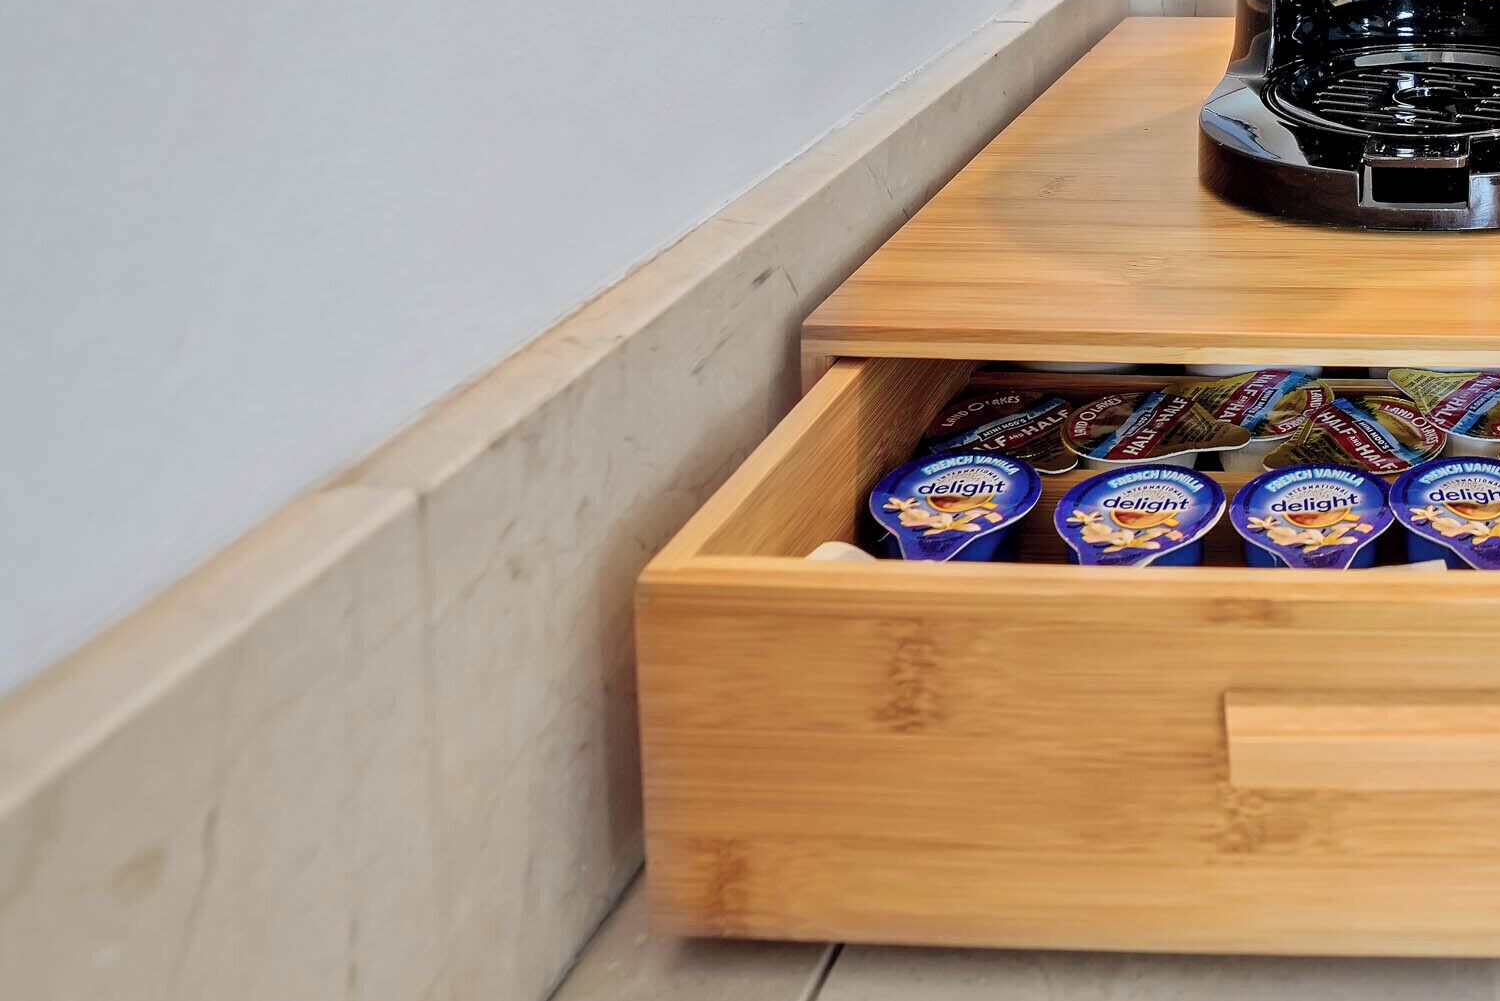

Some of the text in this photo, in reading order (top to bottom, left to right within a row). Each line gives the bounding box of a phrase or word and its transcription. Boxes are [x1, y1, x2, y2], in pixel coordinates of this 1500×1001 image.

[1243, 374, 1276, 396] HALF
[1081, 411, 1096, 421] O
[1094, 395, 1122, 413] LAKES
[1310, 389, 1321, 408] LAND
[1216, 403, 1244, 422] HA
[1432, 397, 1461, 425] HALF
[972, 435, 1007, 451] LF
[1021, 409, 1071, 436] HALF
[1122, 428, 1157, 455] HALF
[1158, 396, 1188, 423] HALF
[1384, 405, 1439, 446] LAND O LAKES
[1317, 411, 1355, 436] HALF
[1355, 444, 1399, 472] HALF
[923, 455, 1020, 476] FRENCH VANILLA
[937, 467, 999, 482] INTERNATIONAL
[1418, 463, 1463, 484] FRENCH
[918, 480, 1006, 497] delight
[1108, 469, 1161, 489] FRENCH
[1266, 468, 1365, 492] FRENCH VANILLA
[1122, 484, 1184, 498] INTERNATIONAL
[1285, 484, 1349, 499] INTERNATIONAL
[1103, 496, 1190, 513] delight
[1271, 493, 1361, 513] delight
